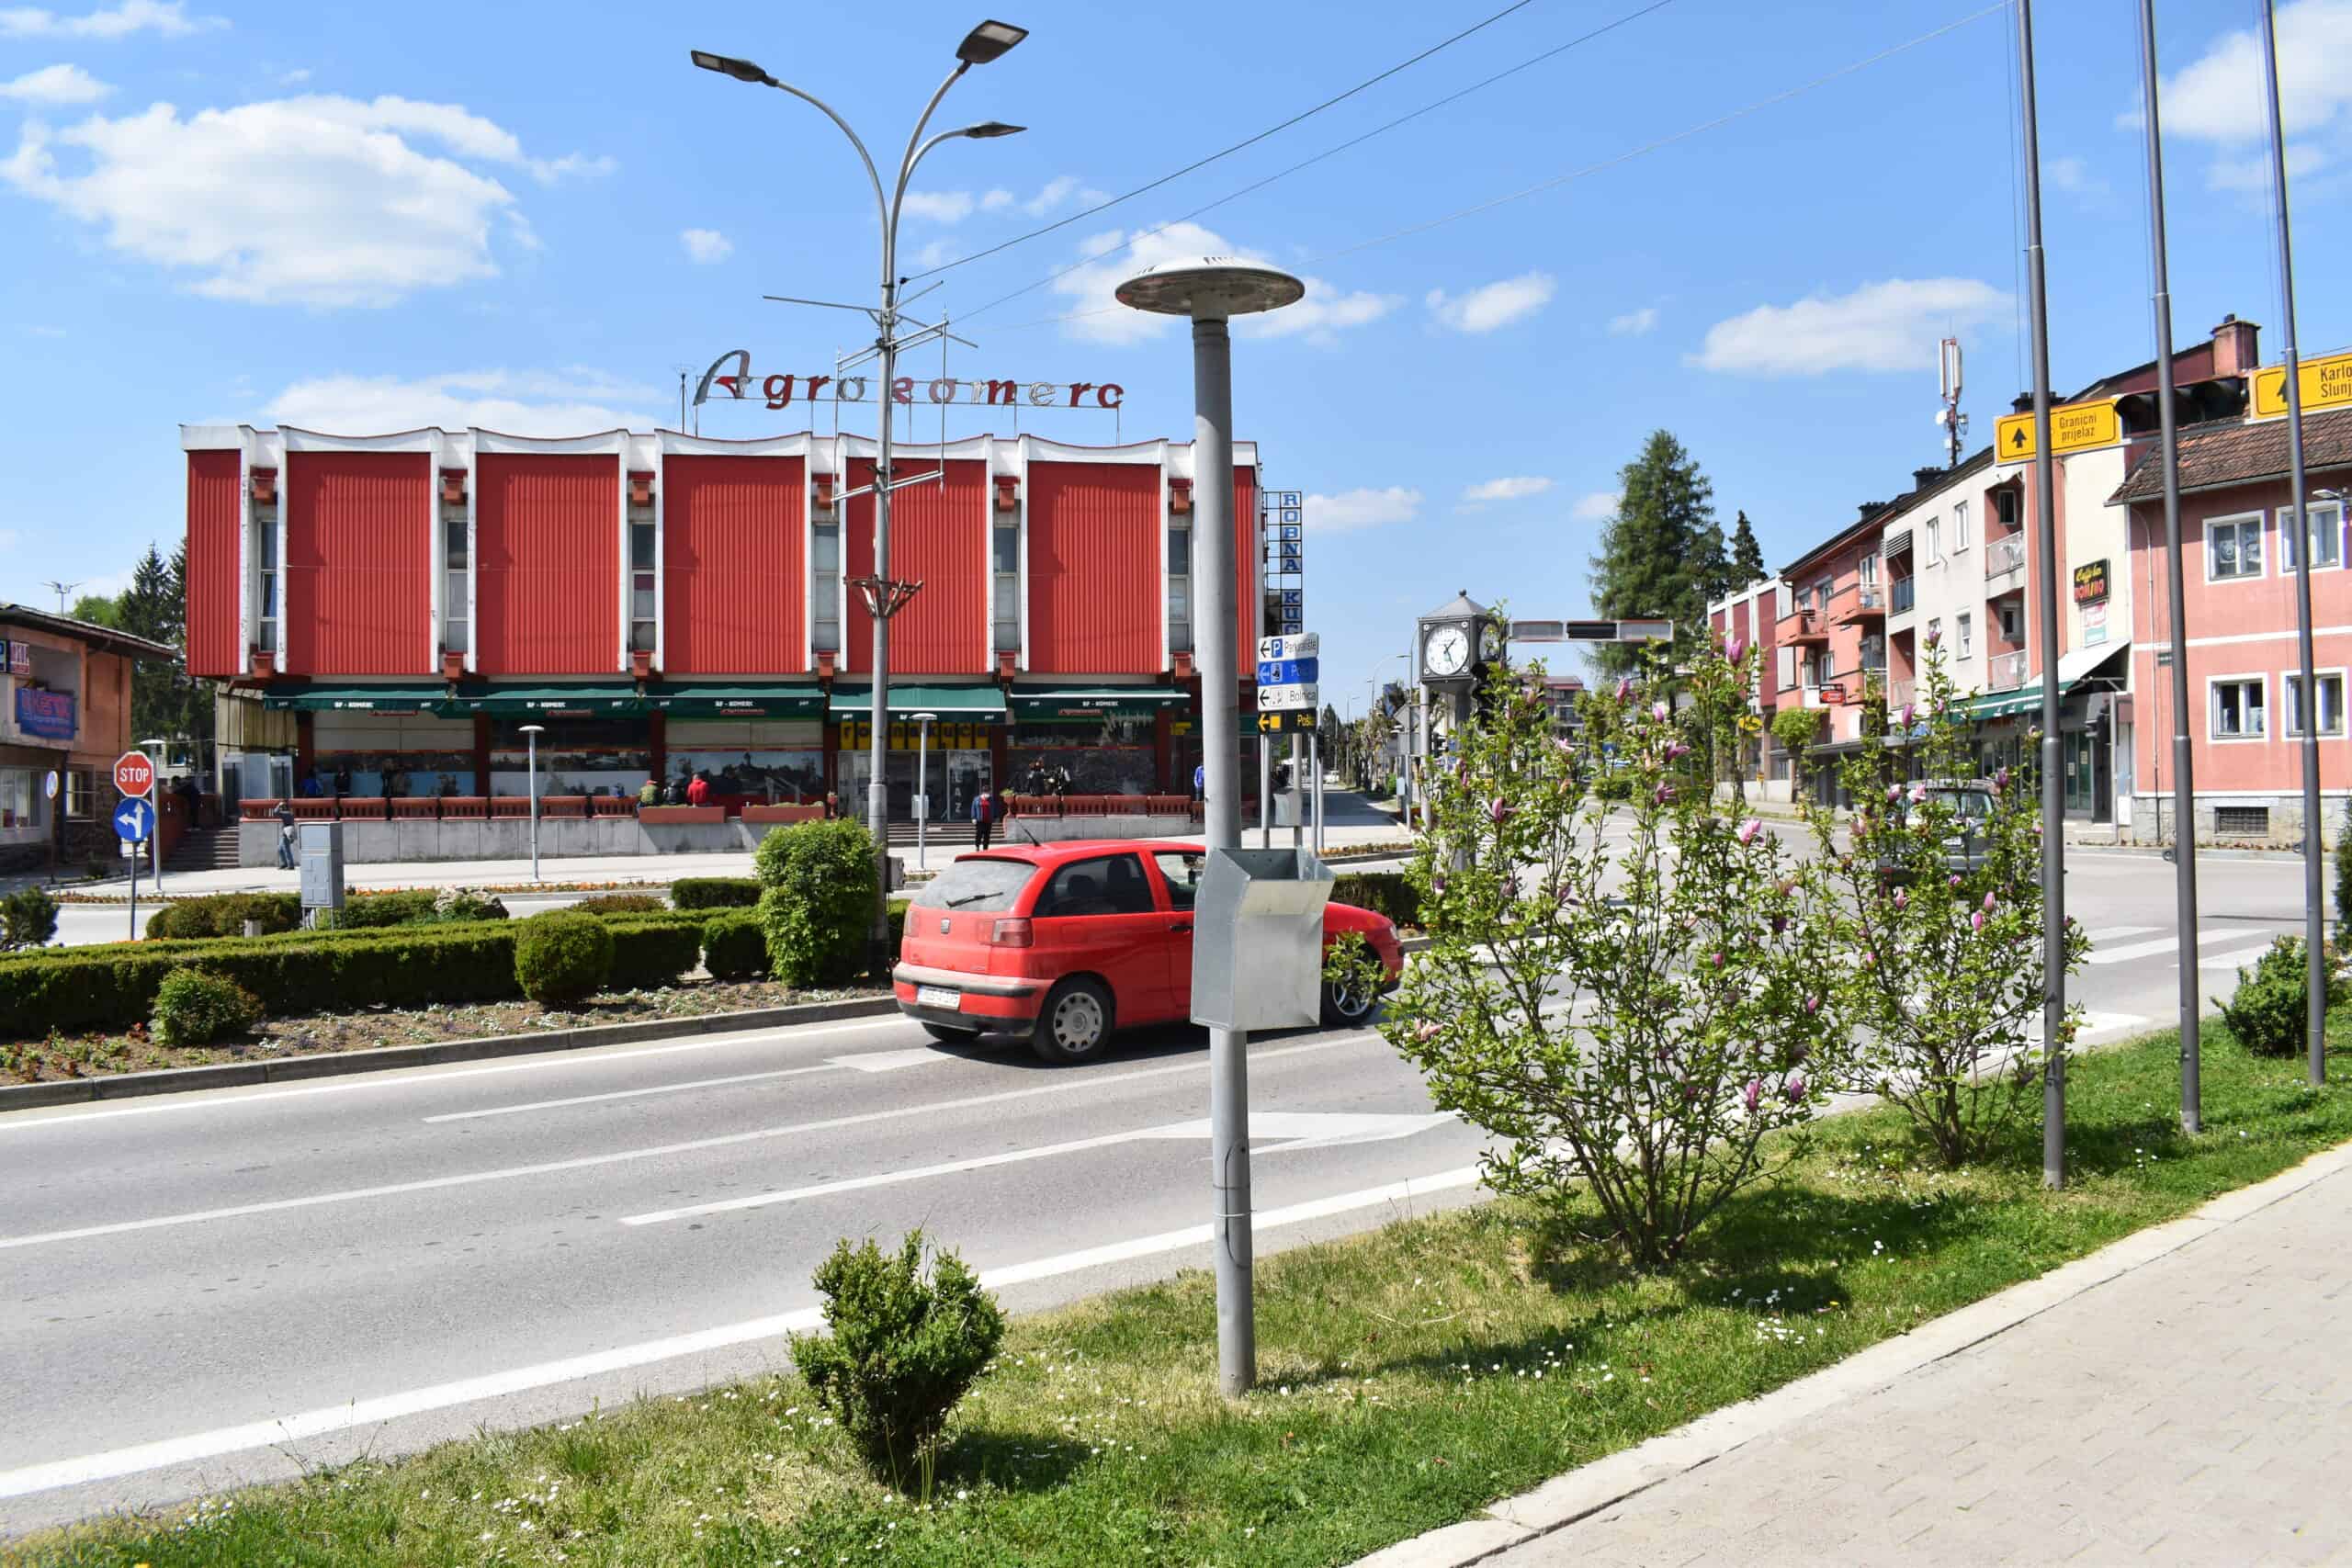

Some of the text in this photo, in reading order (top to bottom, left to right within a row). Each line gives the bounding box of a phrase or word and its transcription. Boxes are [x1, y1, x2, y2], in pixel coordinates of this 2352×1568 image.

[2321, 379, 2352, 398] Slunj
[2062, 426, 2096, 441] prijelaz
[1290, 690, 1317, 702] Bolnica
[119, 768, 149, 783] STOP
